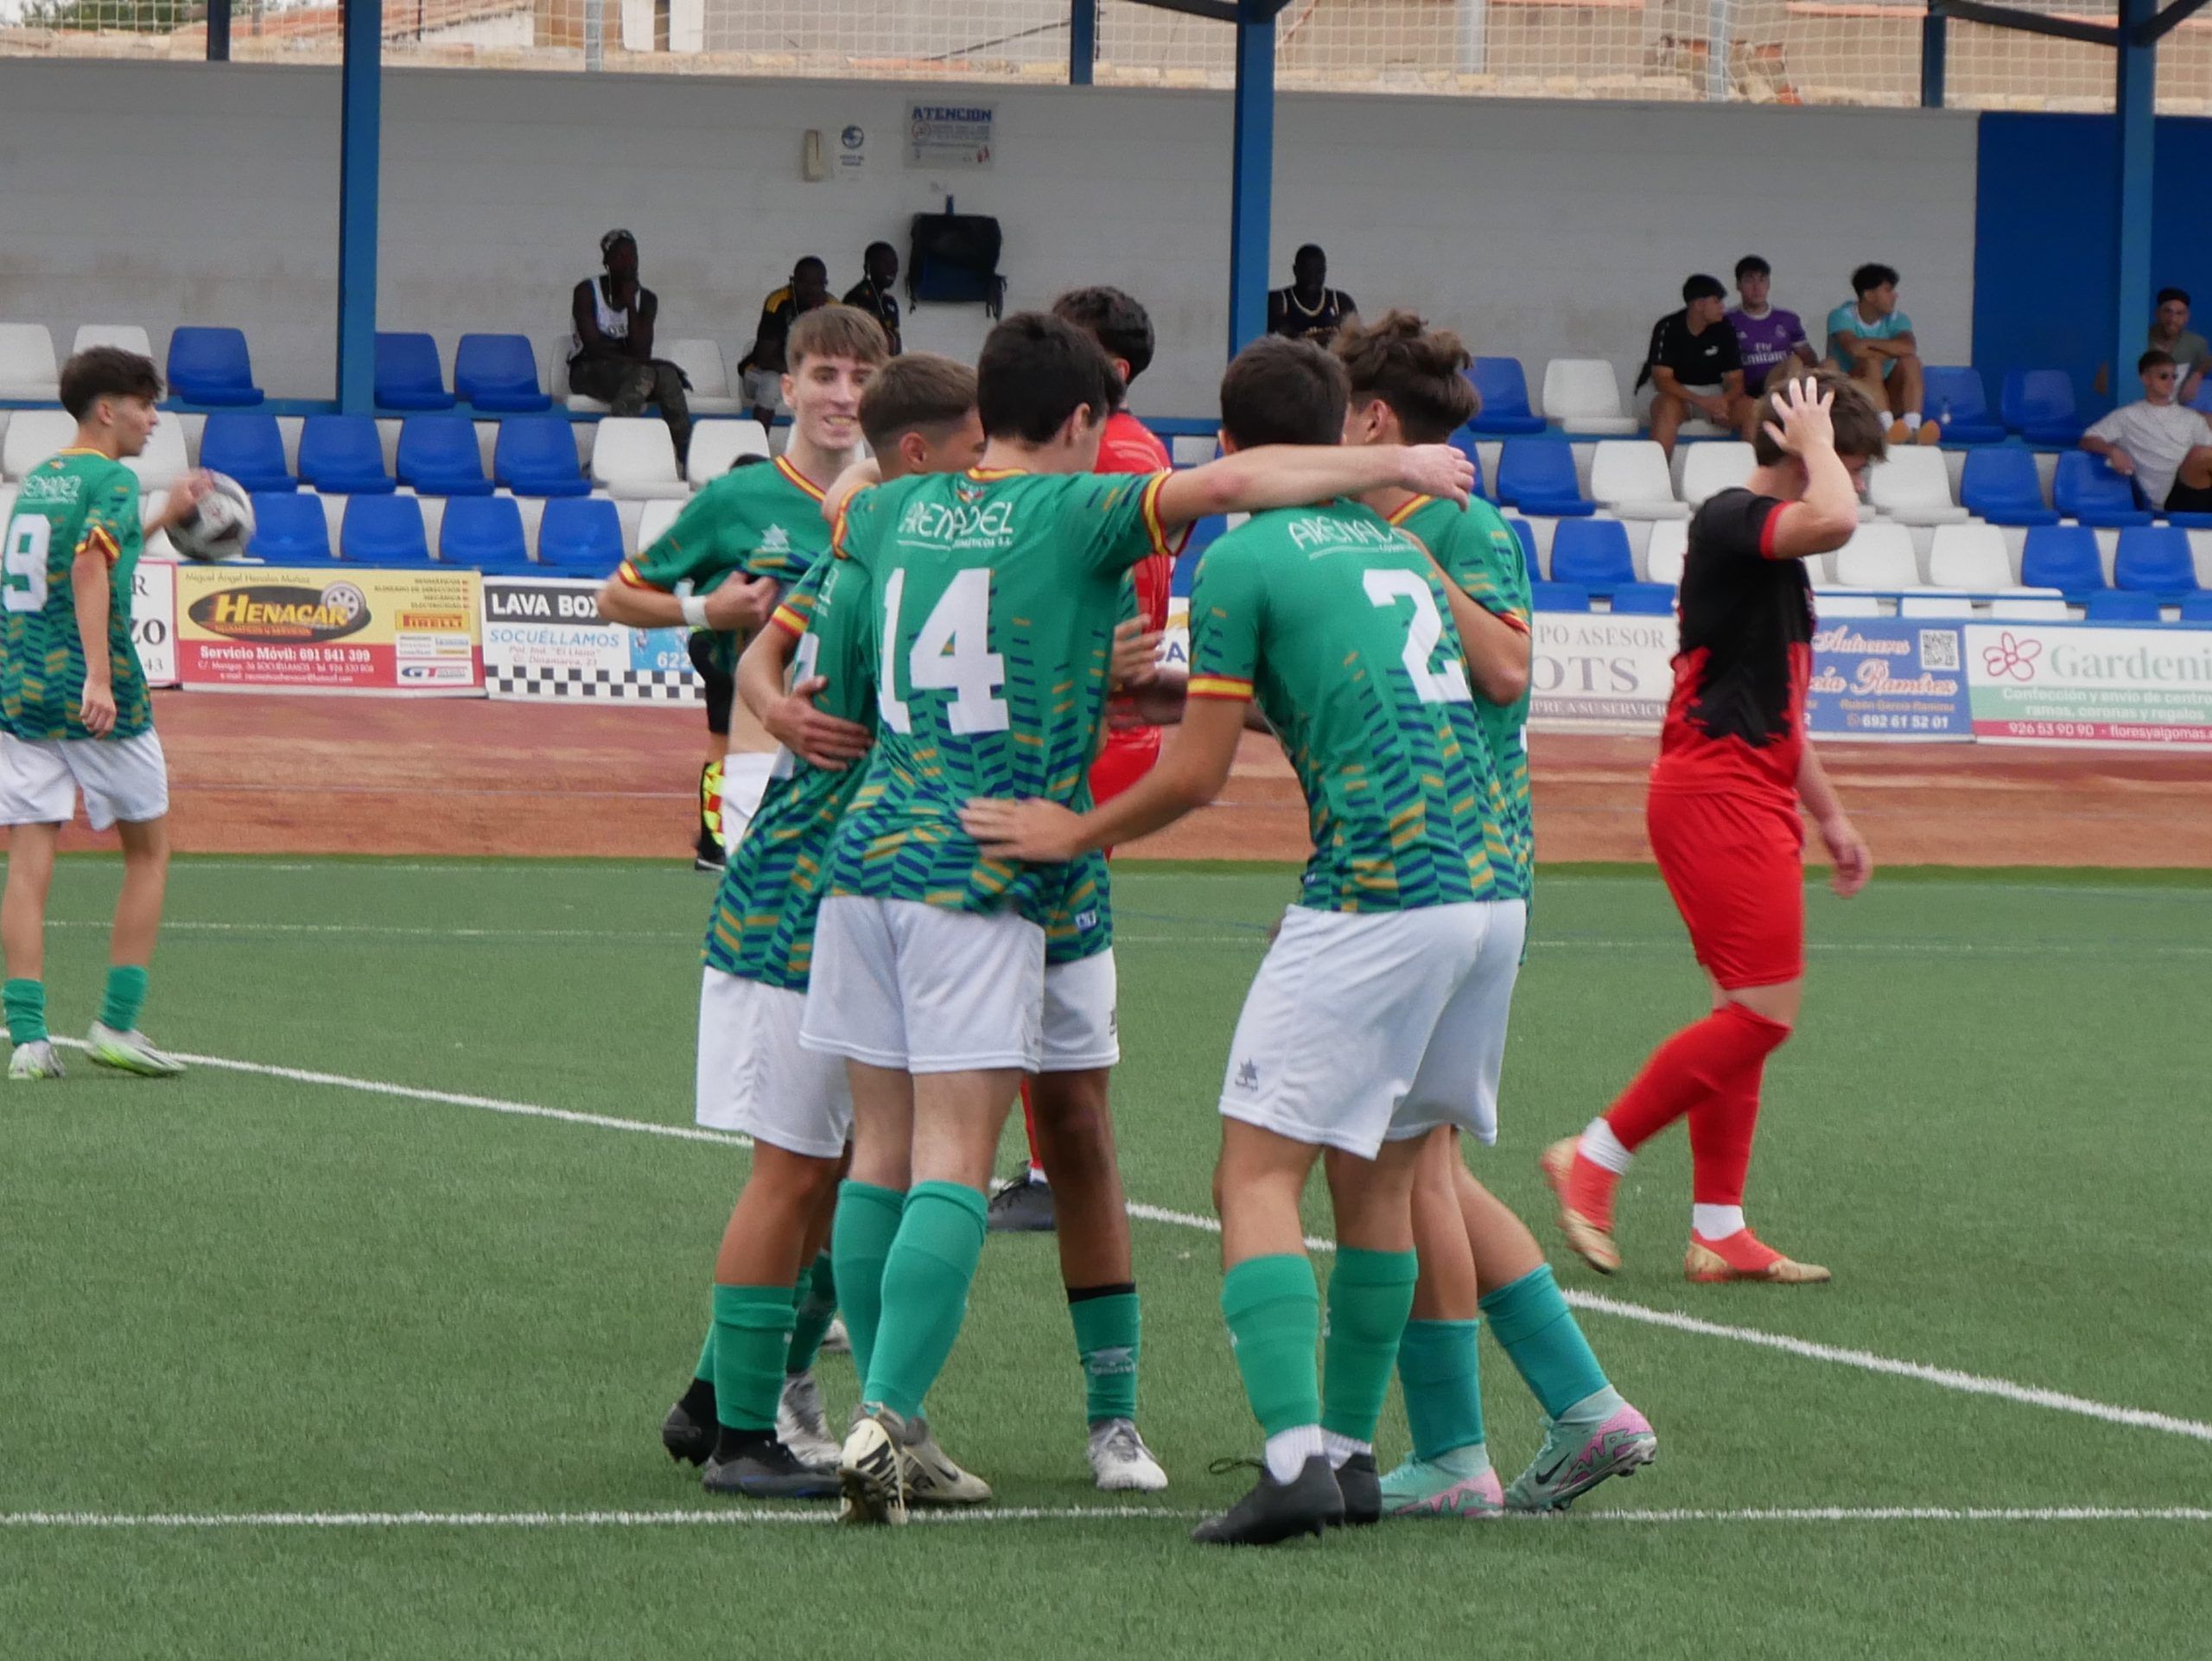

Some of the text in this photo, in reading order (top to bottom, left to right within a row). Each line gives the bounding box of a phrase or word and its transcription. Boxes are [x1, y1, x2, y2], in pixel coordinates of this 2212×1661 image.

[2, 513, 52, 613] 9
[216, 594, 349, 627] HENACAR
[492, 593, 550, 616] LAVA
[403, 614, 463, 627] PIRELLI
[490, 627, 620, 648] SOCUÉLLAMOS
[1361, 567, 1473, 703] 2
[1576, 627, 1666, 648] ASESOR
[200, 646, 254, 659] Servicio
[257, 646, 296, 661] Móvil:
[880, 567, 1010, 735] 14
[1532, 654, 1639, 693] OTS
[1862, 714, 1888, 728] 692
[1891, 714, 1908, 729] 61
[1932, 716, 1949, 729] 01
